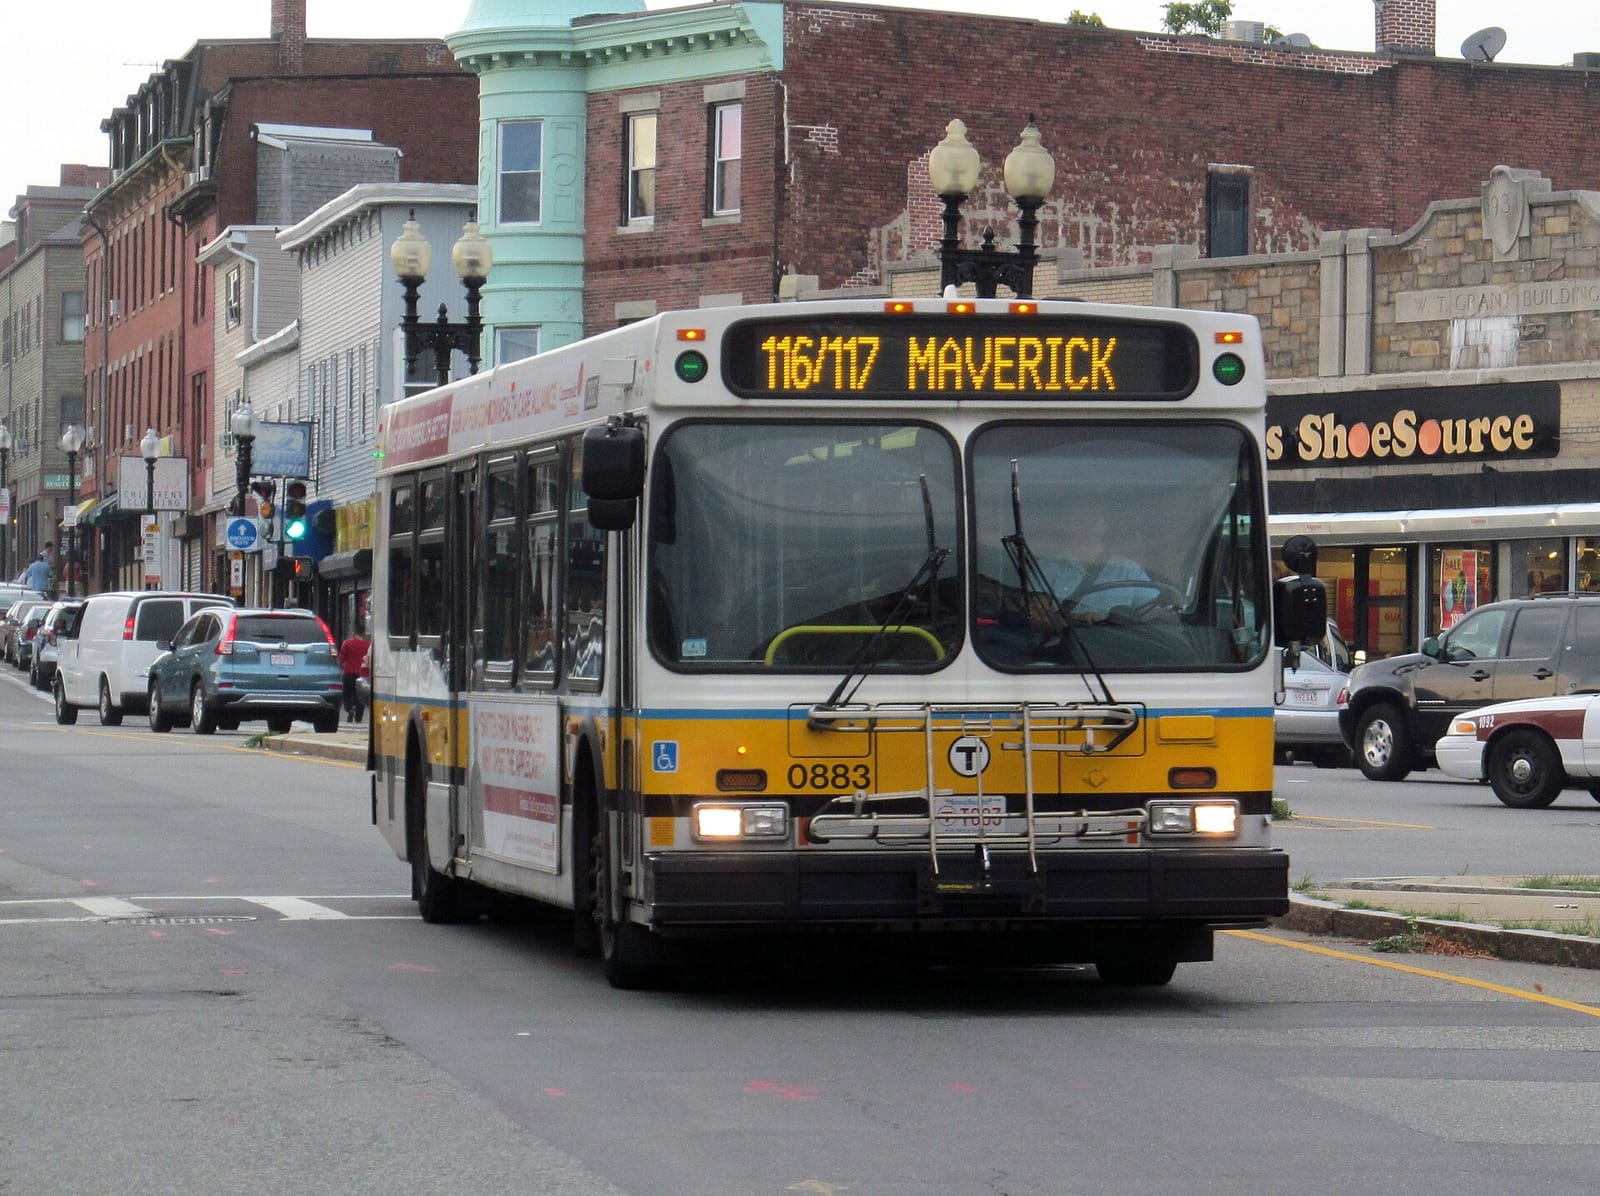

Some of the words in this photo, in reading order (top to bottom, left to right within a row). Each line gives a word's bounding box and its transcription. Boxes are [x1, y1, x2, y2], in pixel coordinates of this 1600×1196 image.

[1523, 286, 1600, 307] BUILDING
[761, 336, 880, 390] 116/117
[908, 336, 1116, 390] MAVERICK
[1298, 409, 1534, 461] ShoeSource
[127, 499, 180, 507] CLOHING
[1445, 558, 1462, 569] SALE
[1479, 715, 1495, 728] 1092
[787, 764, 871, 789] 0883
